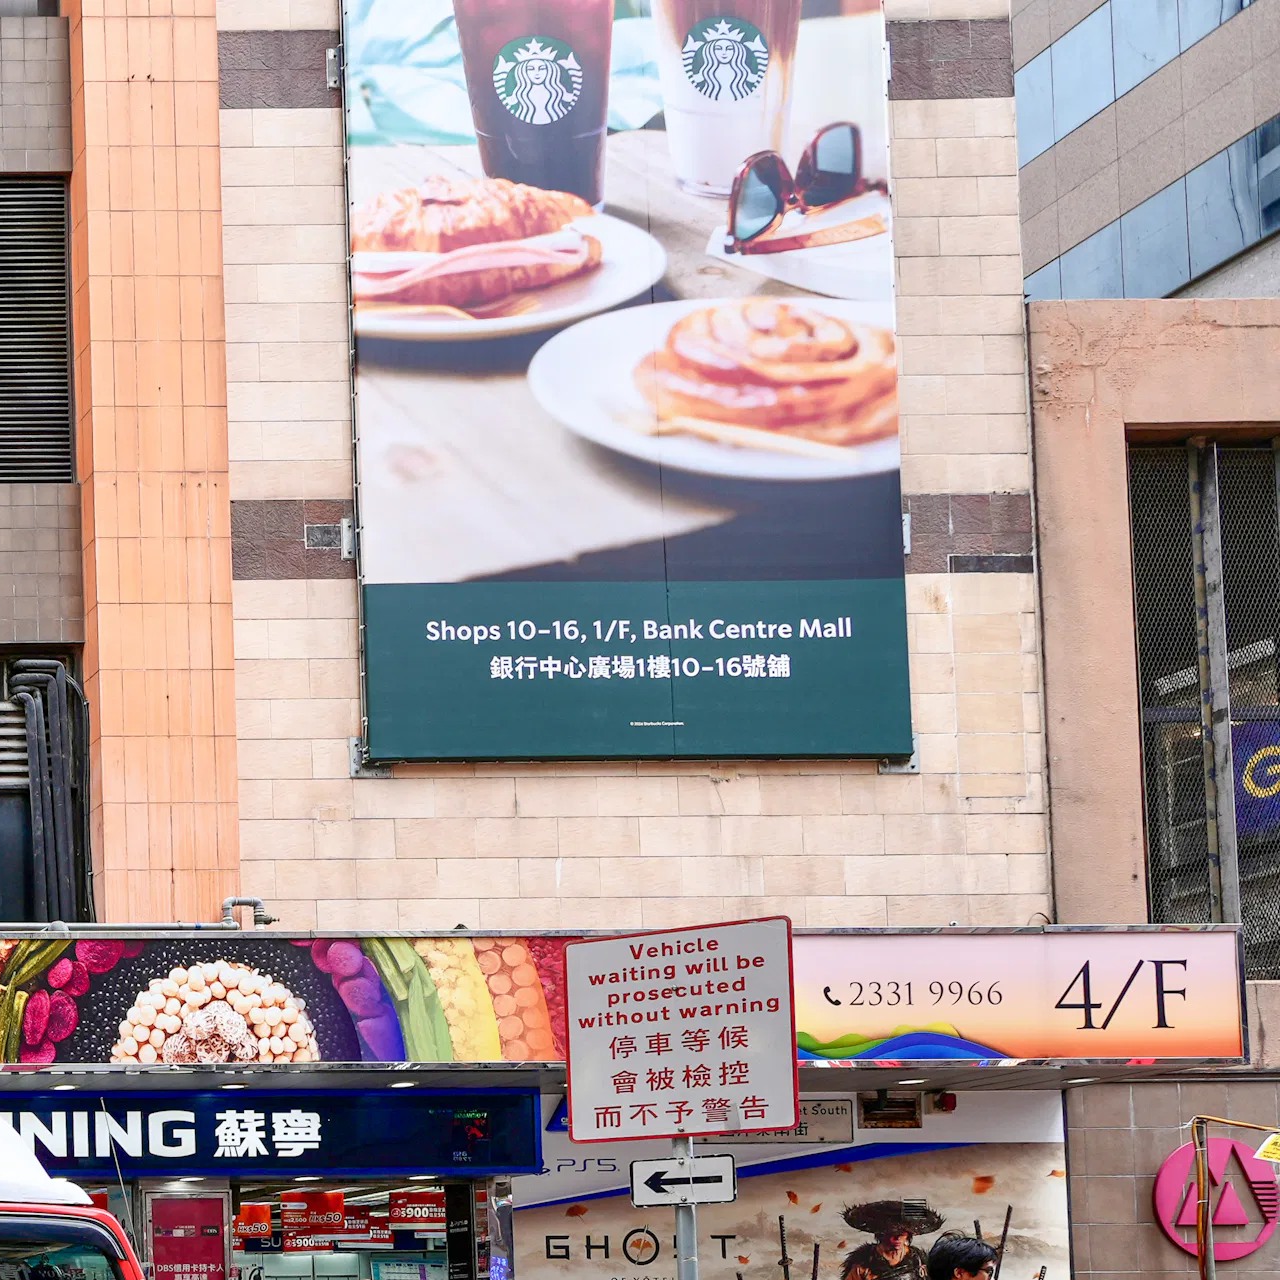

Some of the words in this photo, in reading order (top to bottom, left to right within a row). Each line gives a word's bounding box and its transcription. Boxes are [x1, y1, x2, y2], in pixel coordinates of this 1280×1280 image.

[425, 620, 501, 645] Shops
[592, 619, 637, 644] 1/F,
[643, 618, 704, 640] Bank
[708, 618, 793, 639] Centre
[799, 616, 853, 638] Mall
[629, 937, 719, 960] Vehicle
[588, 964, 676, 986] waiting
[685, 957, 729, 975] will
[736, 954, 766, 970] be
[608, 976, 746, 1008] prosecuted
[848, 979, 915, 1007] 2331
[928, 979, 1004, 1007] 9966
[1054, 958, 1189, 1030] 4/F
[578, 1006, 671, 1029] without
[679, 996, 780, 1019] warning
[608, 1025, 749, 1060] 停車等候
[611, 1060, 750, 1094] 會被檢控
[593, 1094, 770, 1129] 而不予警告
[812, 1105, 848, 1116] South
[213, 1109, 323, 1158] 蘇寧
[557, 1158, 618, 1172] PS5
[545, 1225, 737, 1266] GHOT
